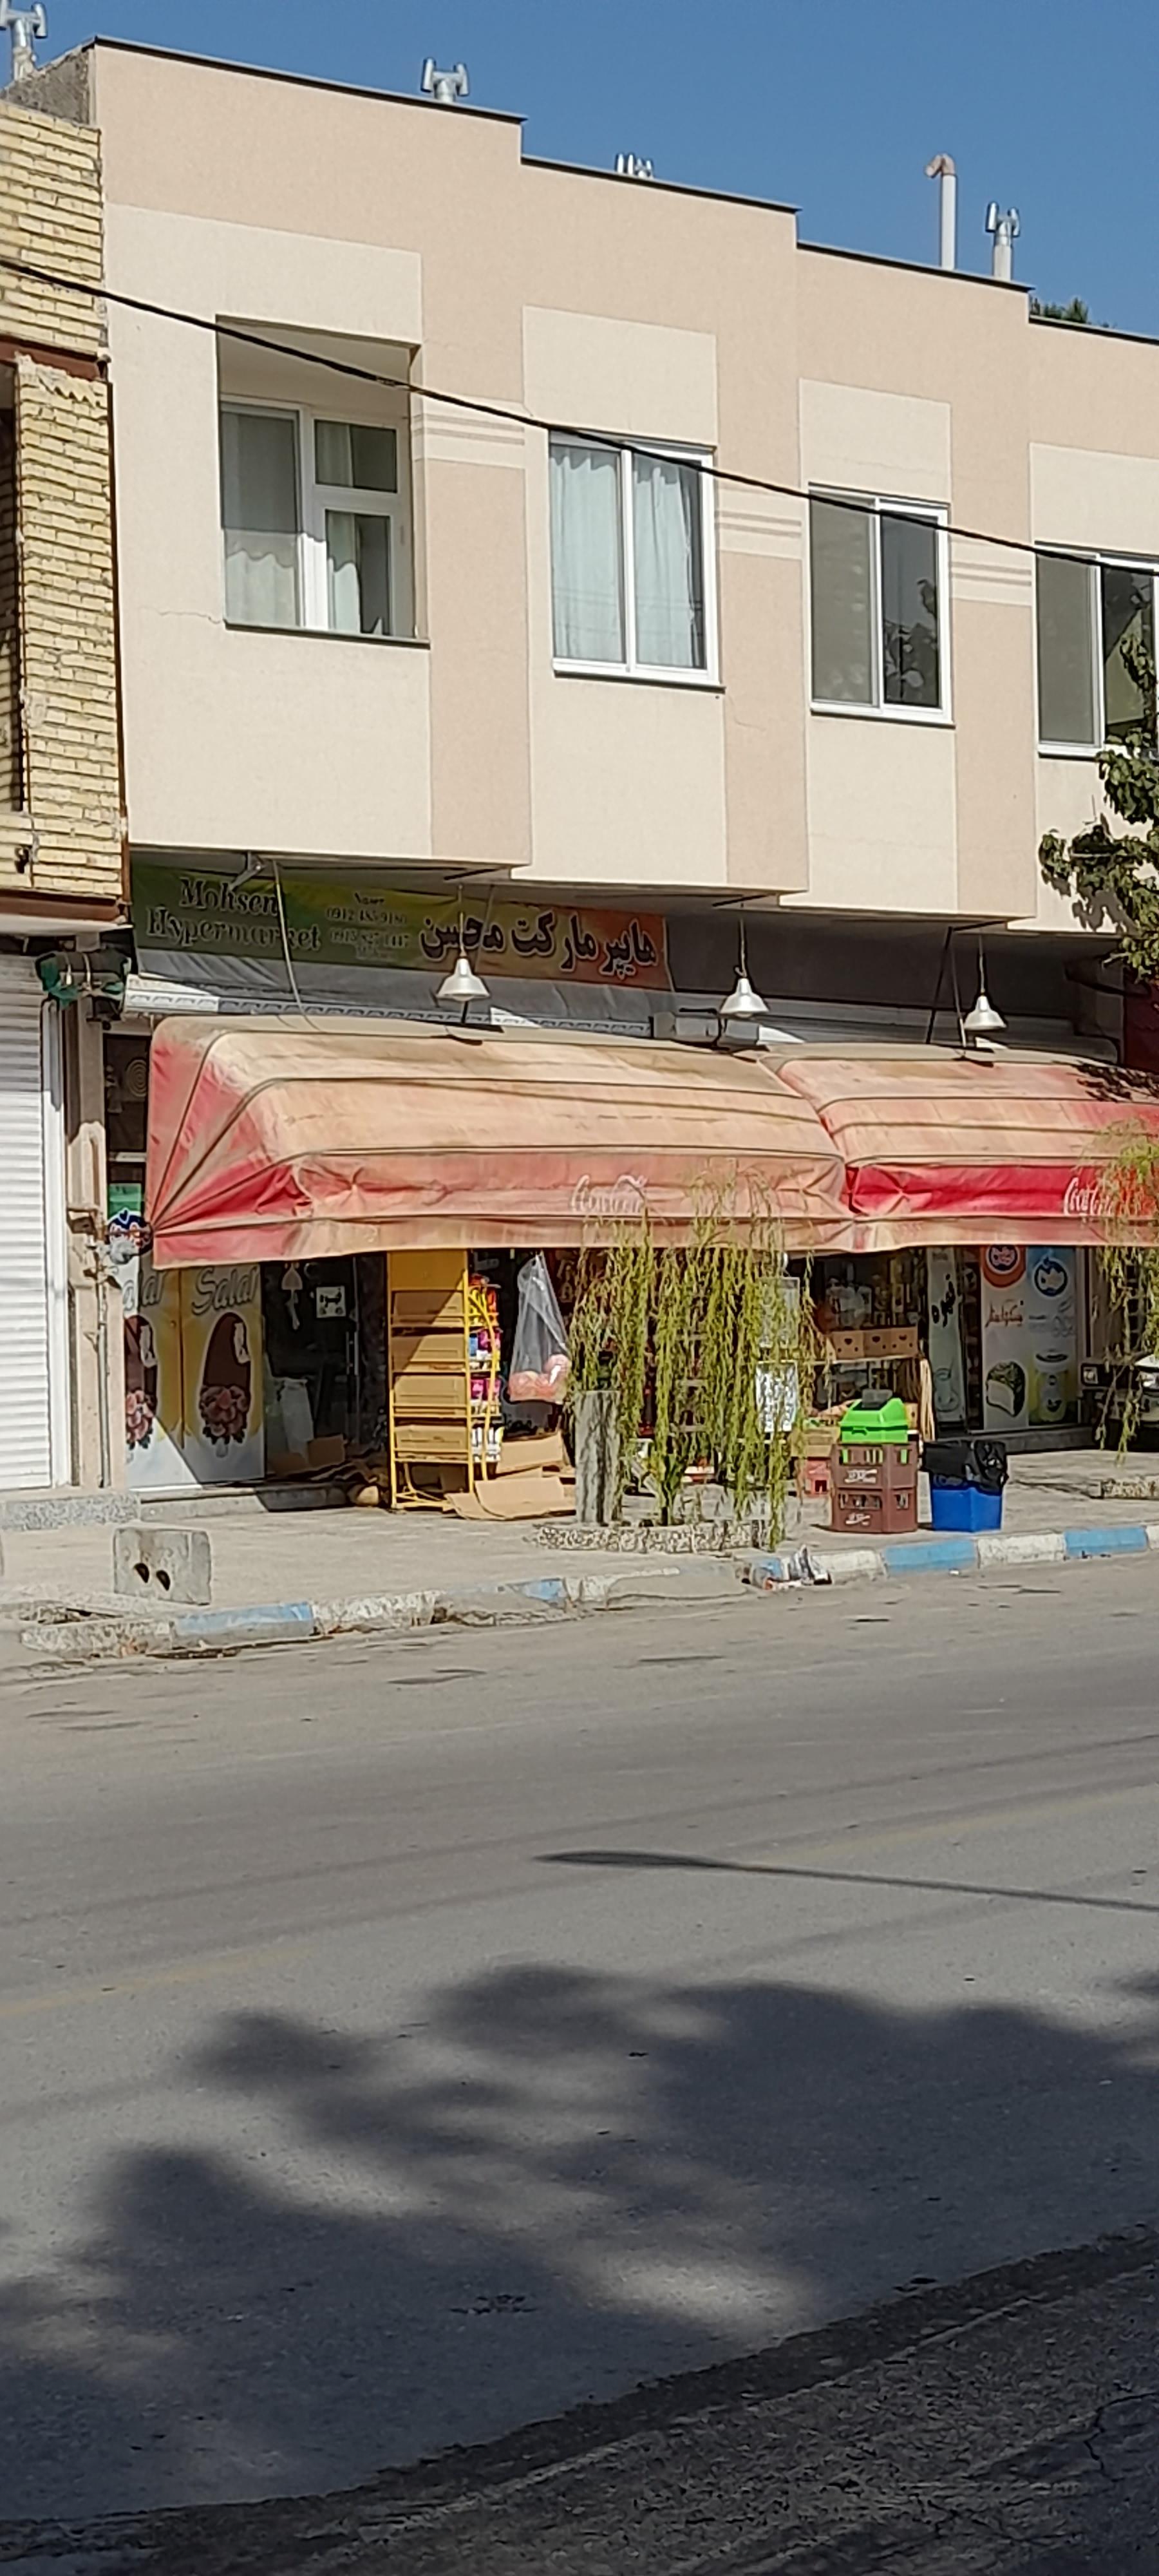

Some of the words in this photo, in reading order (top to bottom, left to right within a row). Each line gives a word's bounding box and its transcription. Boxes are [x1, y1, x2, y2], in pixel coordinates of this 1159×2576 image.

[179, 876, 279, 916] Mohsen
[419, 916, 506, 961] محسن
[598, 918, 658, 980] هایپر
